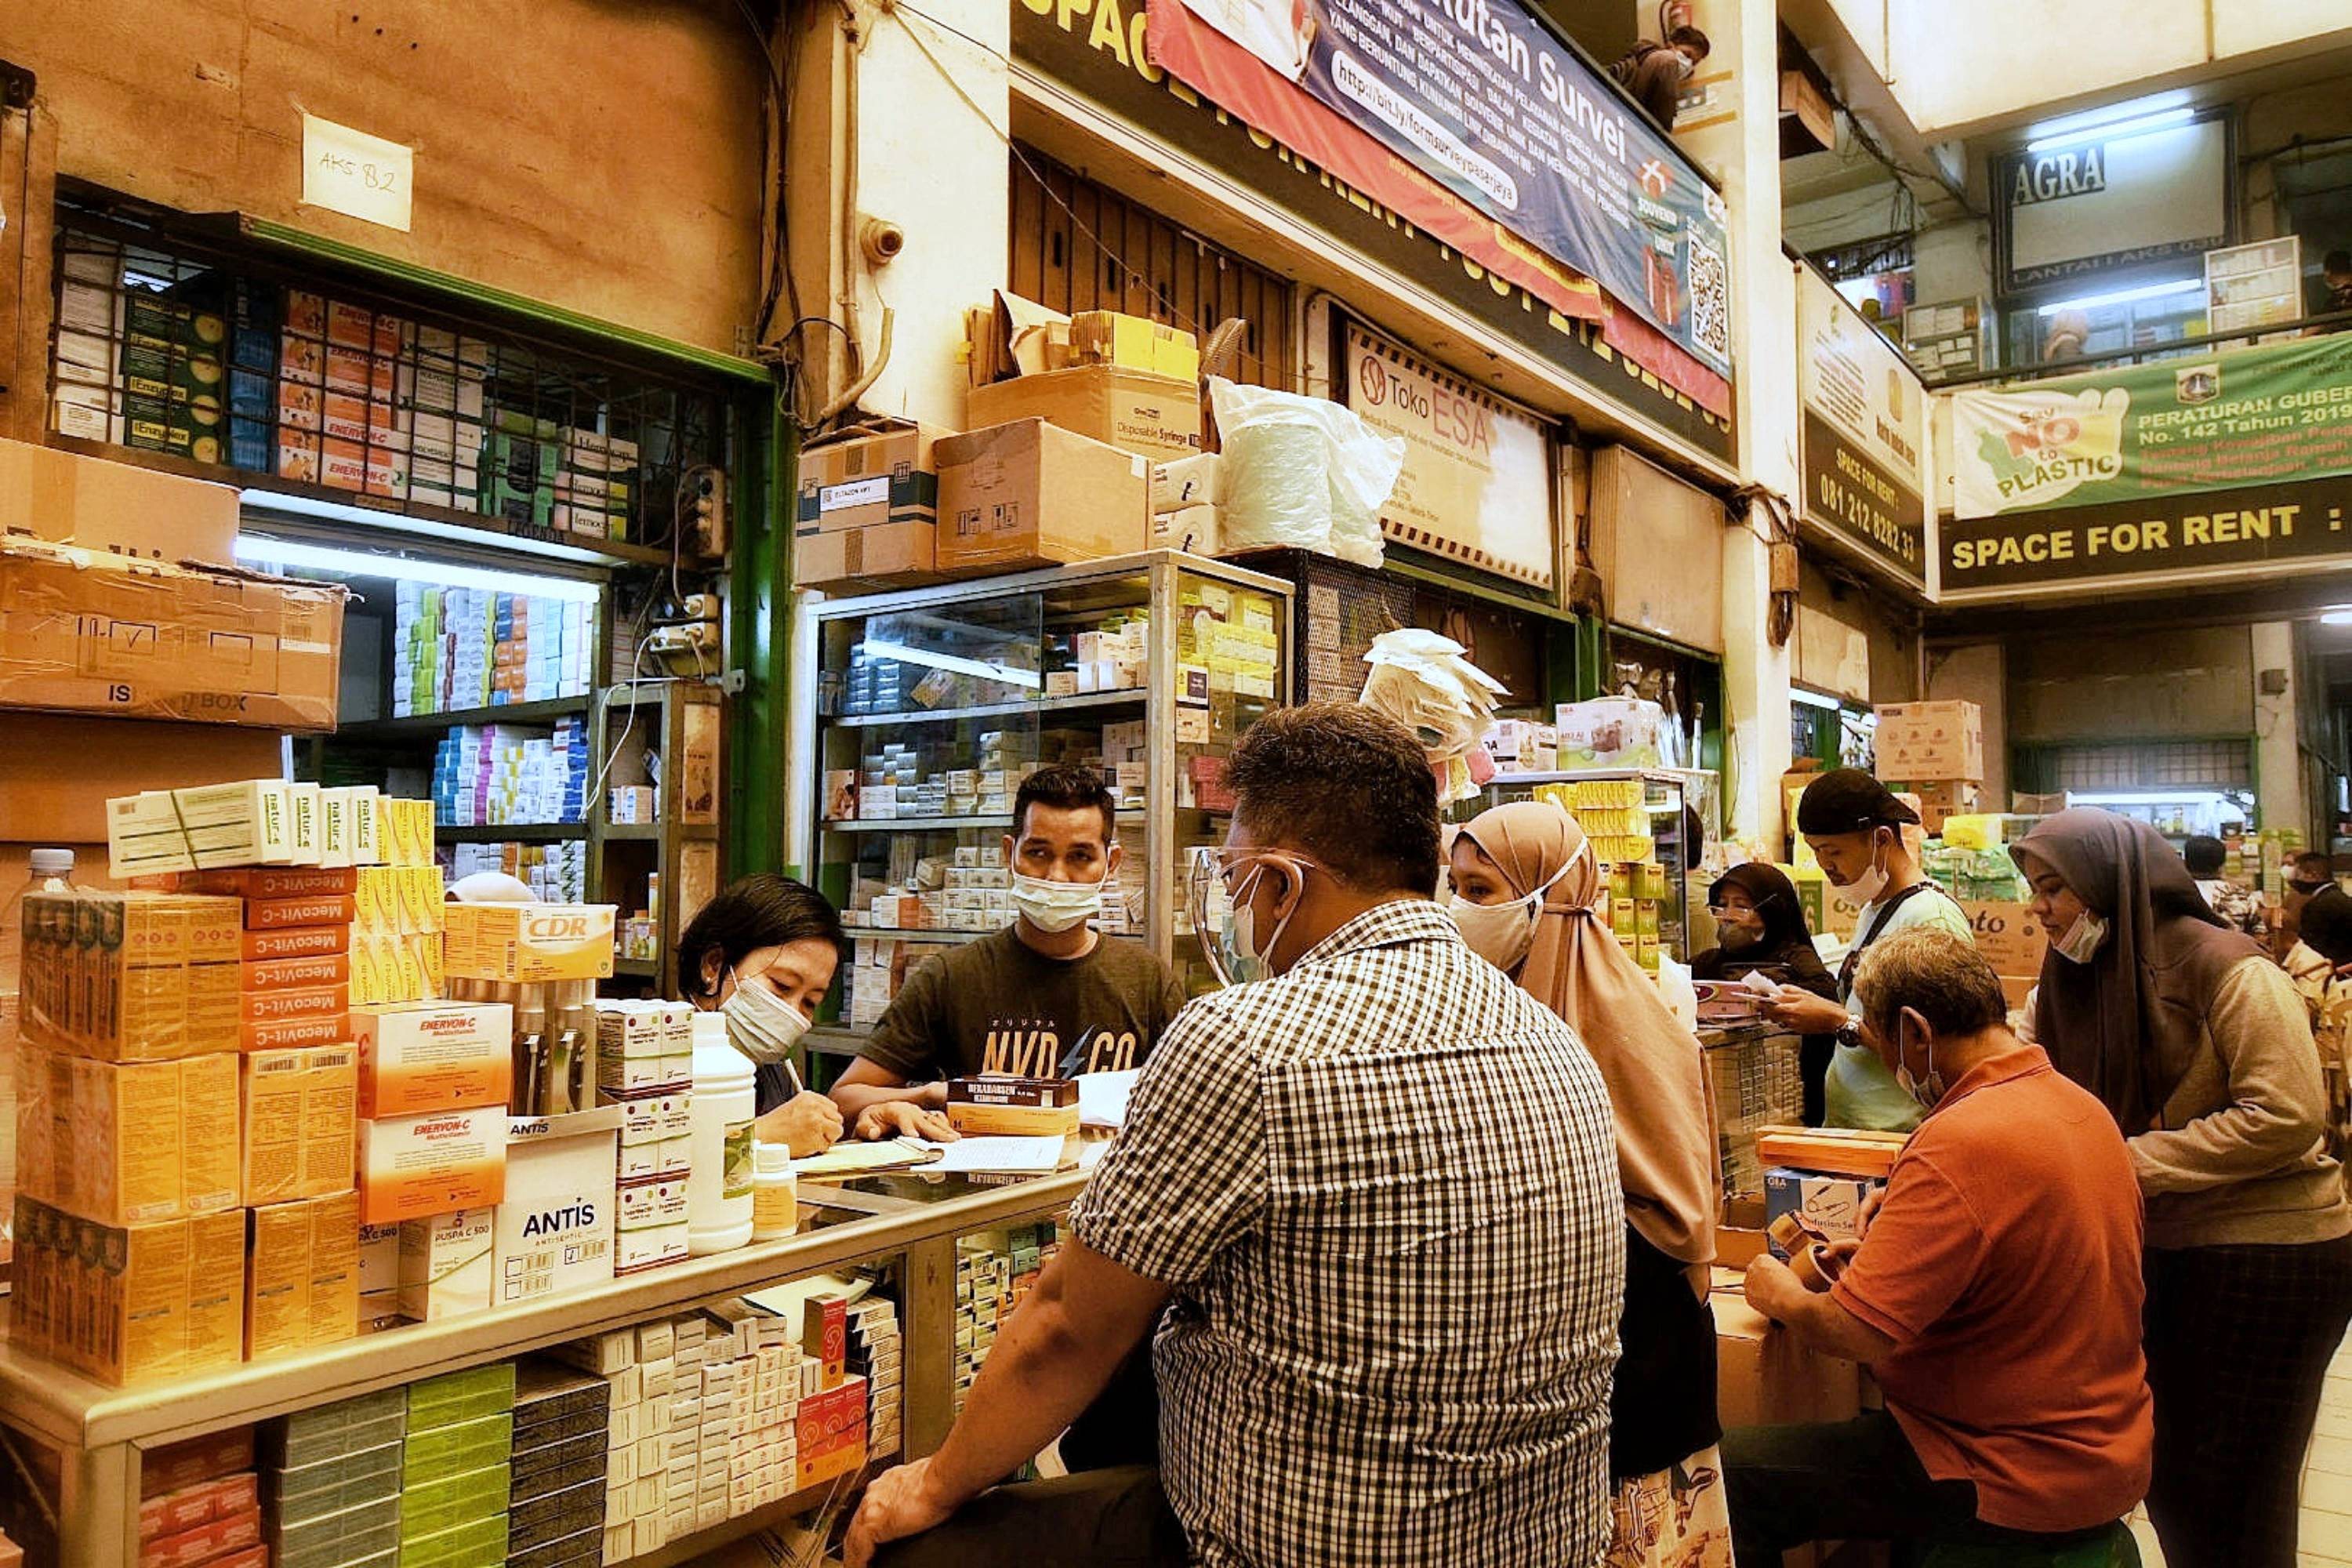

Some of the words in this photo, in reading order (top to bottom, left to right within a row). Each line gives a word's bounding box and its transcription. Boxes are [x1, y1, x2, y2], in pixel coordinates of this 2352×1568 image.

[1329, 9, 1357, 42] YANG
[1023, 0, 1198, 107] PAC
[1395, 34, 1416, 64] DAN
[1418, 52, 1464, 102] DAPATKAN
[1538, 51, 1625, 165] Survei
[2013, 147, 2105, 205] AGRA
[1117, 422, 1158, 437] Disposable
[1160, 428, 1187, 445] Syringe
[1388, 374, 1428, 419] Toko
[1432, 387, 1490, 456] ESA
[2005, 416, 2080, 459] NO
[2138, 397, 2272, 430] PERATURAN
[2139, 431, 2175, 445] No.
[2181, 422, 2219, 441] 142
[2223, 414, 2294, 433] Tahun
[2300, 404, 2352, 425] 2019
[1837, 448, 1860, 485] SPACE
[1862, 470, 1876, 494] FOR
[1877, 481, 1895, 508] RENT
[1997, 454, 2115, 499] PLASTIC
[2038, 448, 2058, 463] to
[1820, 474, 1844, 517] 081
[1848, 492, 1870, 535] 212
[1952, 530, 2074, 570] SPACE
[2088, 519, 2169, 555] FOR
[2183, 505, 2301, 546] RENT
[270, 793, 281, 845] natur-e
[301, 797, 311, 848] natur-e
[332, 801, 341, 851] natur-e
[361, 800, 371, 848] natur-e
[528, 916, 588, 938] CDR
[419, 1017, 477, 1032] ENERVON-C
[414, 1119, 471, 1137] ENERVON-C
[435, 1230, 464, 1242] PUSPA
[466, 1228, 472, 1237] C
[474, 1225, 489, 1235] 500
